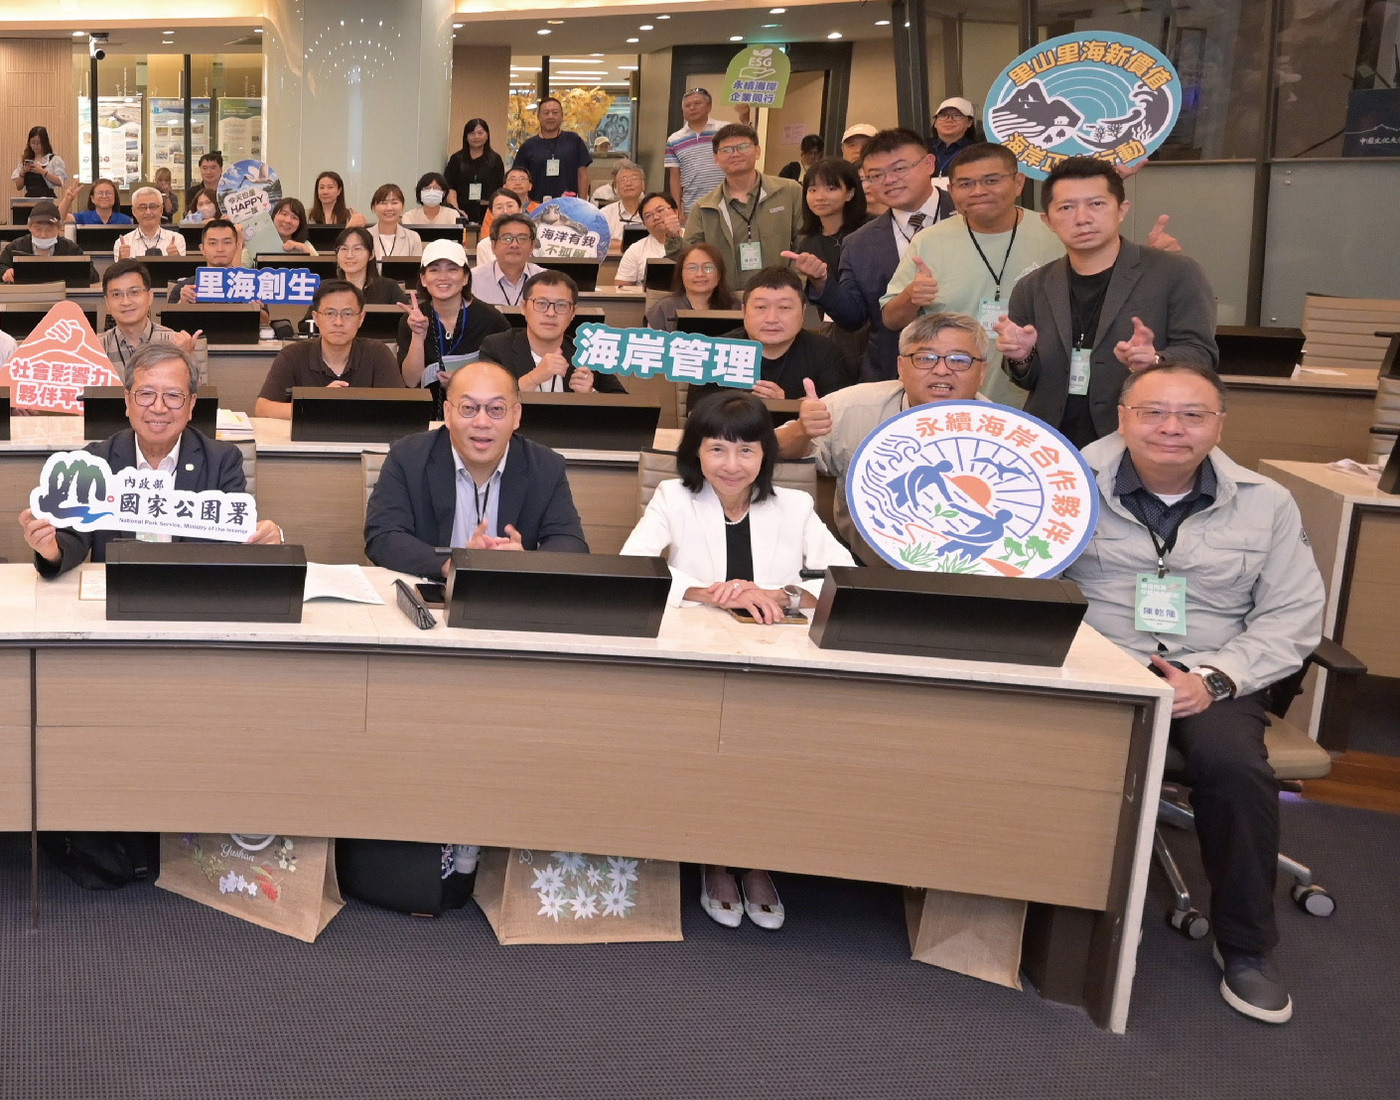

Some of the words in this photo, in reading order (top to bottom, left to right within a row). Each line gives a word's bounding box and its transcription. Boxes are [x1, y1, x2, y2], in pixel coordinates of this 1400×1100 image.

[748, 57, 772, 67] ESG
[1007, 40, 1174, 91] 里山里海新價值
[729, 92, 775, 104] 企業同行
[732, 80, 778, 92] 永續海岸
[1001, 131, 1147, 172] 海岸正行動
[230, 194, 264, 215] HAPPY
[540, 228, 596, 248] 海洋有我
[197, 267, 318, 302] 里海創生
[578, 327, 757, 384] 海岸管理
[11, 359, 111, 386] 社會影響力
[915, 412, 1082, 546] 永續海岸合作夥伴
[119, 493, 249, 526] 國家公園署
[119, 517, 143, 525] National
[184, 523, 207, 531] Ministry
